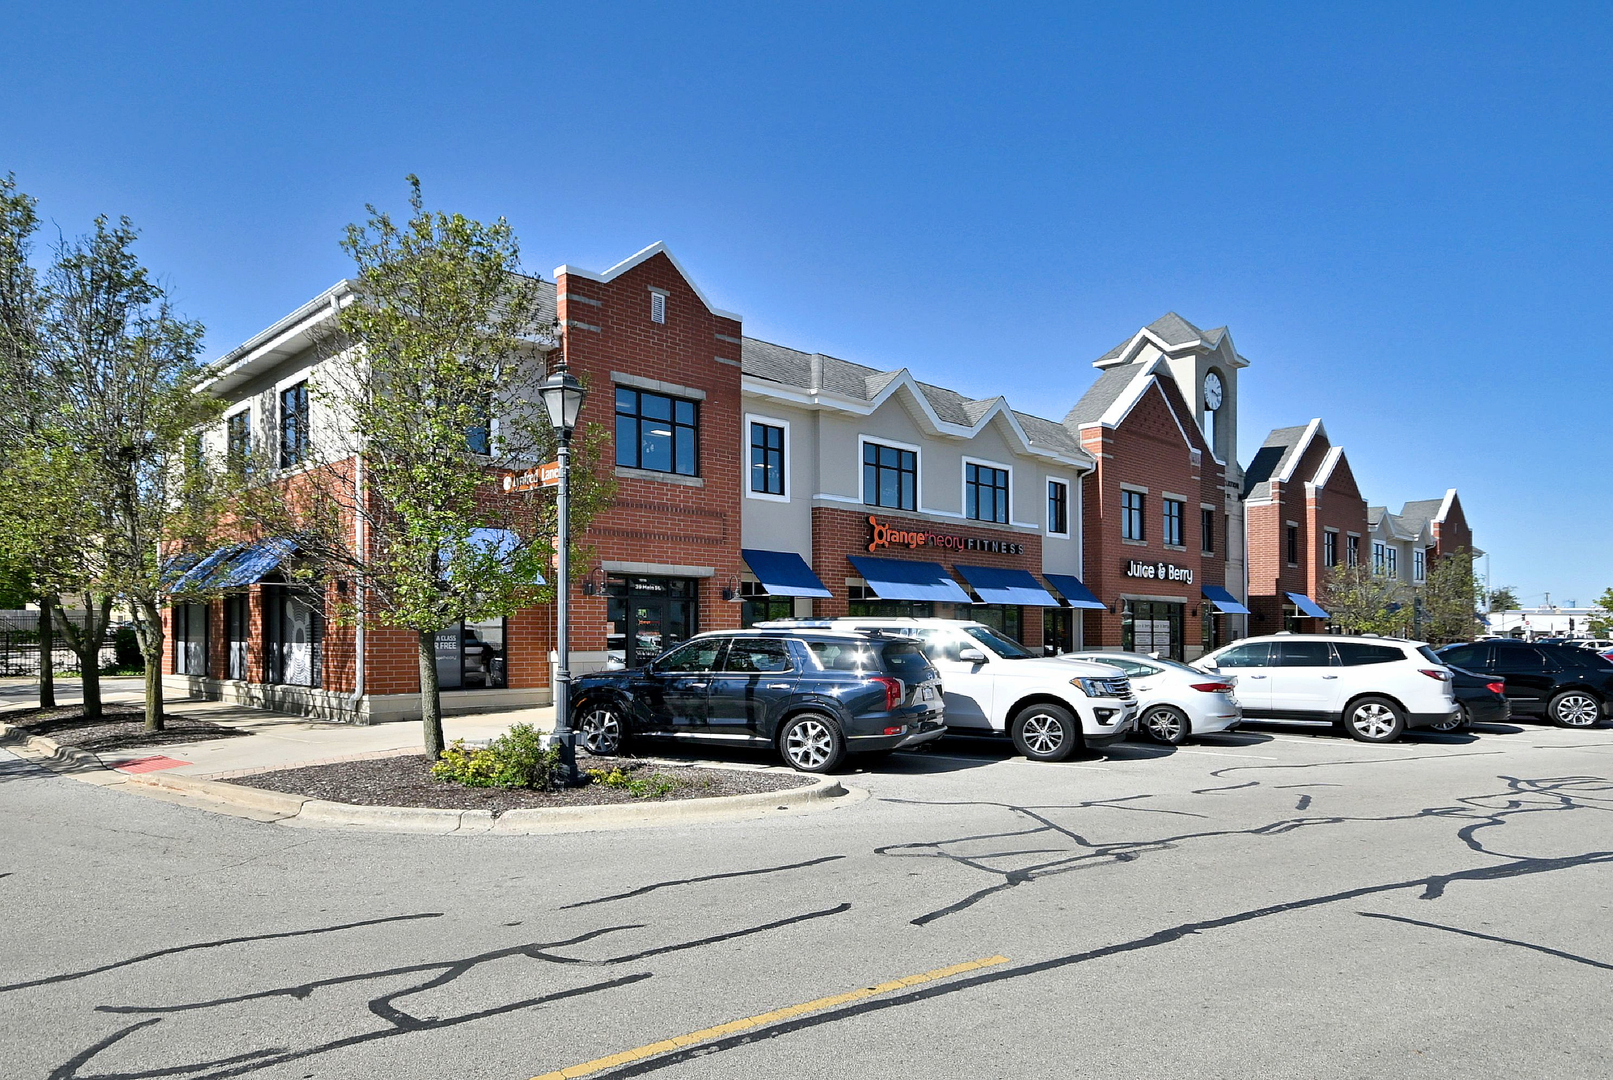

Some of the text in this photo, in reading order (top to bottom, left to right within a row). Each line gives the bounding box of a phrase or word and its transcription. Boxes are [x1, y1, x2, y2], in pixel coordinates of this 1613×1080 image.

[541, 466, 559, 482] Lane
[968, 538, 1025, 556] FITNESS
[1127, 560, 1193, 585] Juice & Berry
[440, 642, 457, 650] FREE
